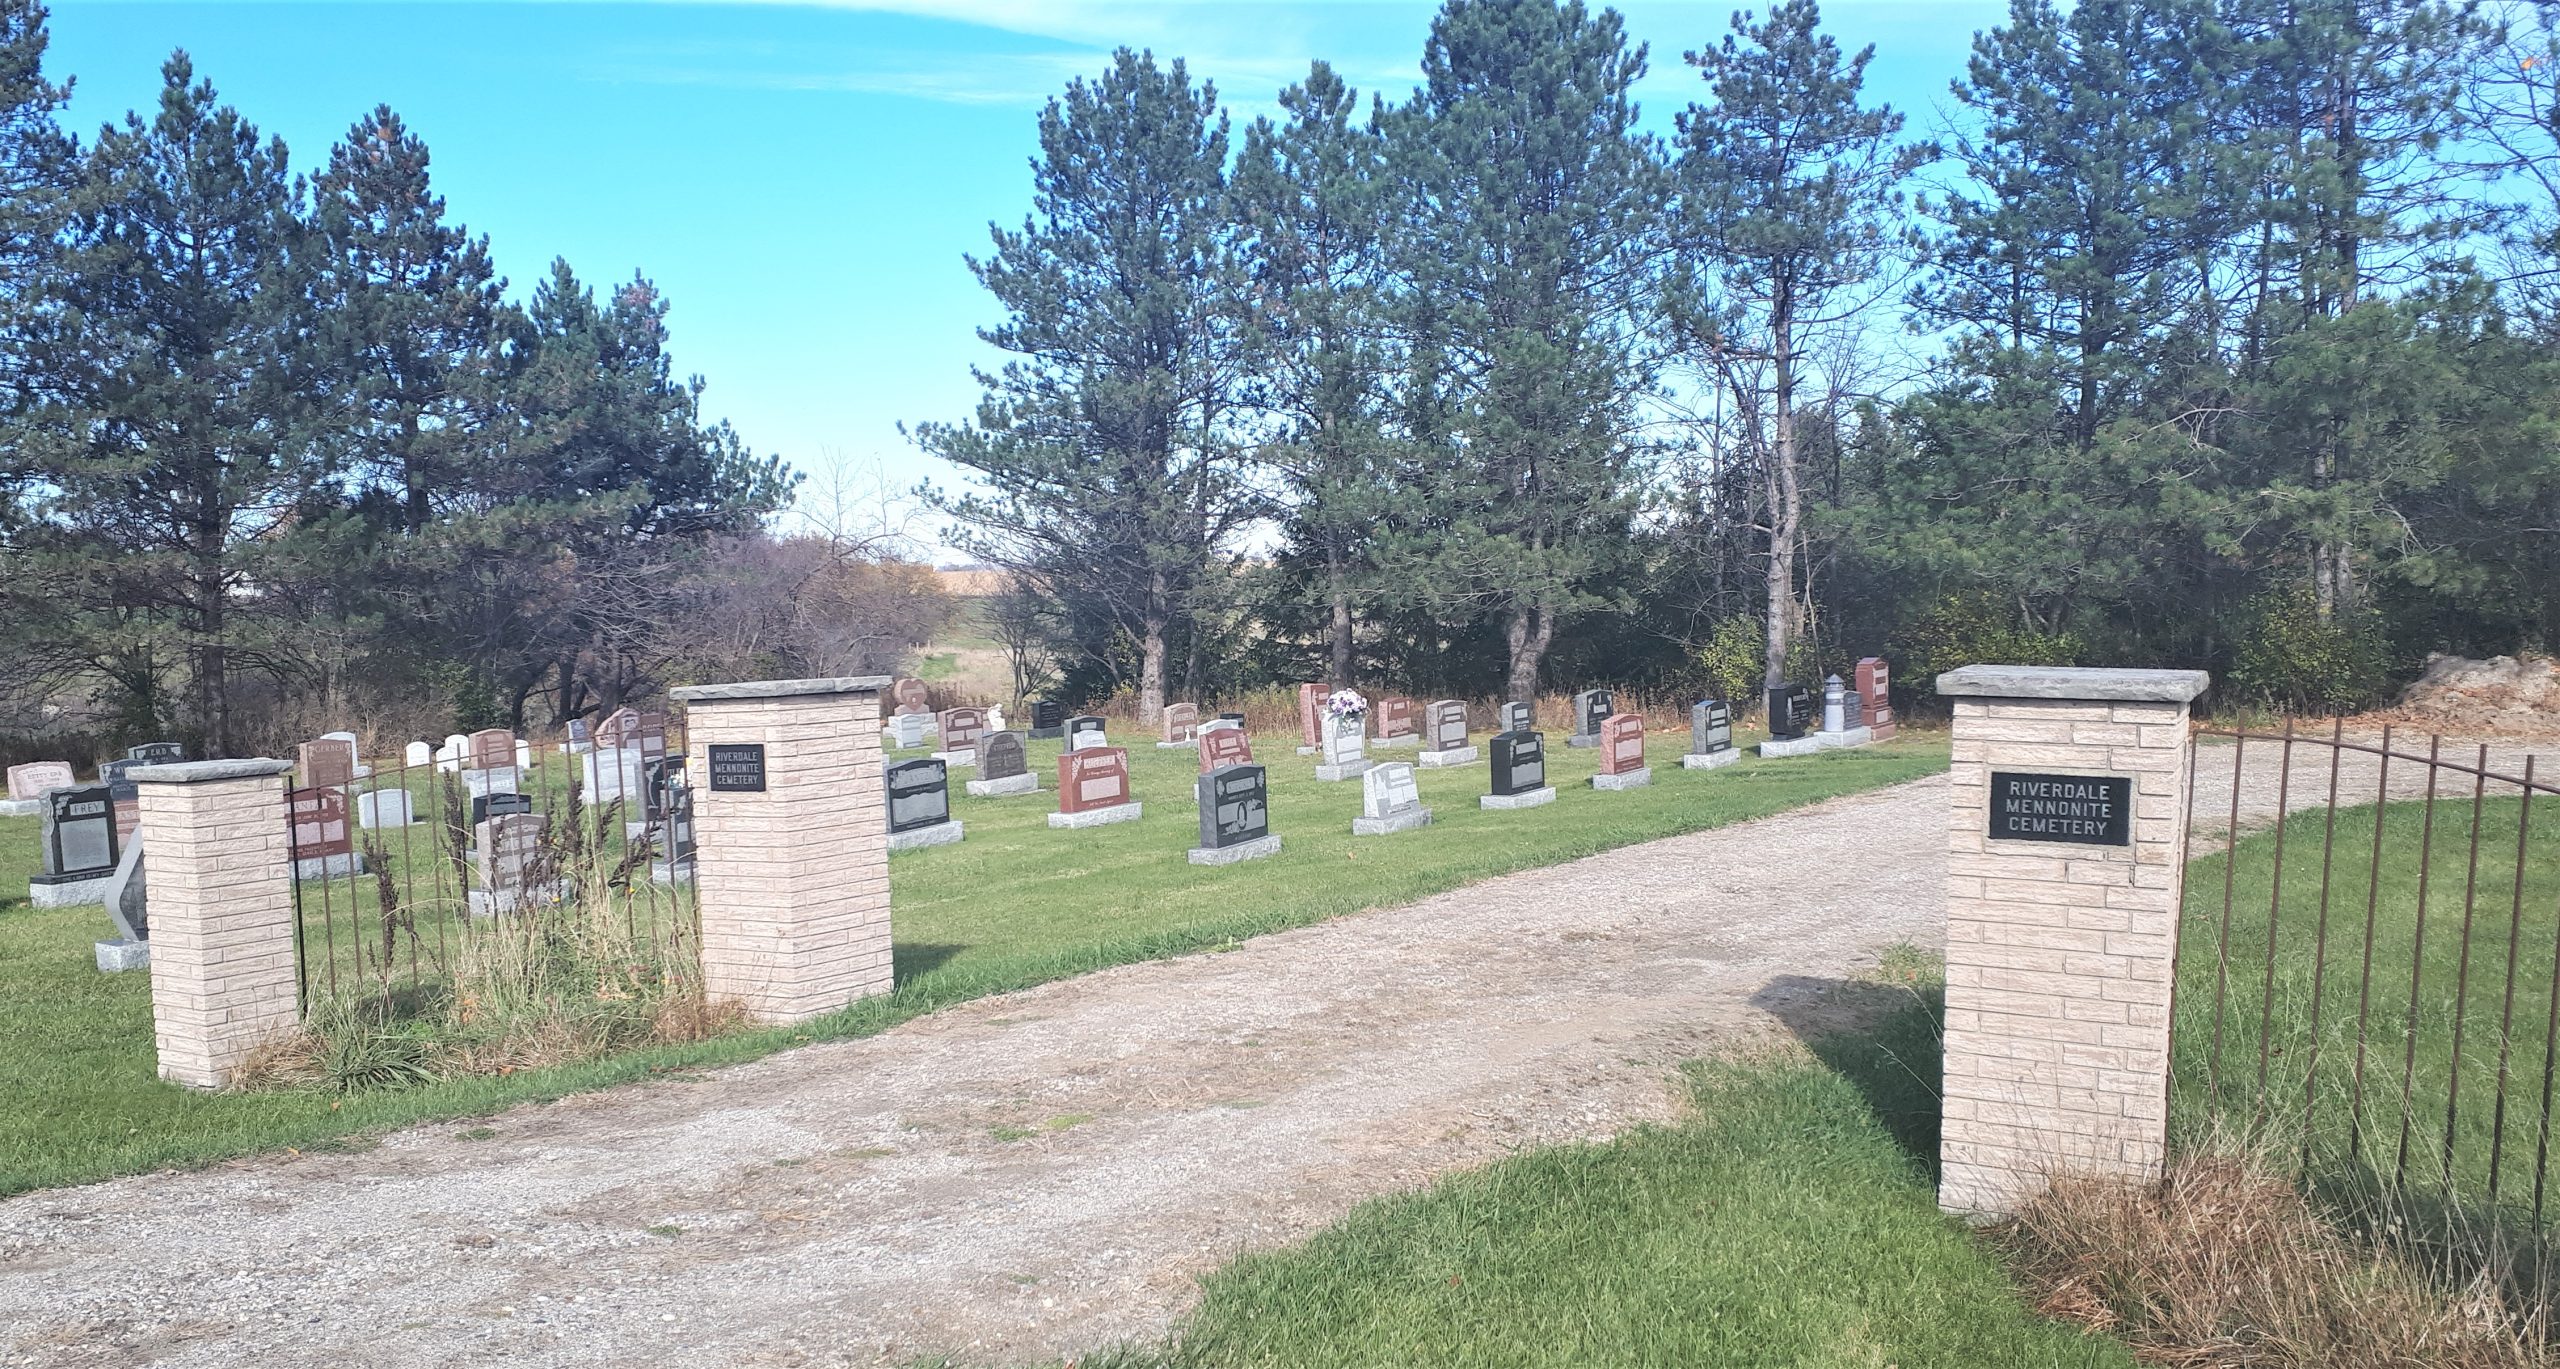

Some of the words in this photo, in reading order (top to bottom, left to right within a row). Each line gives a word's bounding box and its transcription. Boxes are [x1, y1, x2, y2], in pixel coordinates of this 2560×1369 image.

[715, 751, 758, 762] RIVERDALE
[714, 763, 760, 773] MENNONITE
[716, 775, 758, 785] CEMETERY
[2009, 781, 2110, 800] RIVERDALE
[74, 803, 100, 814] FREY
[2005, 799, 2112, 818] MENNONITE
[2008, 817, 2108, 836] CEMETERY
